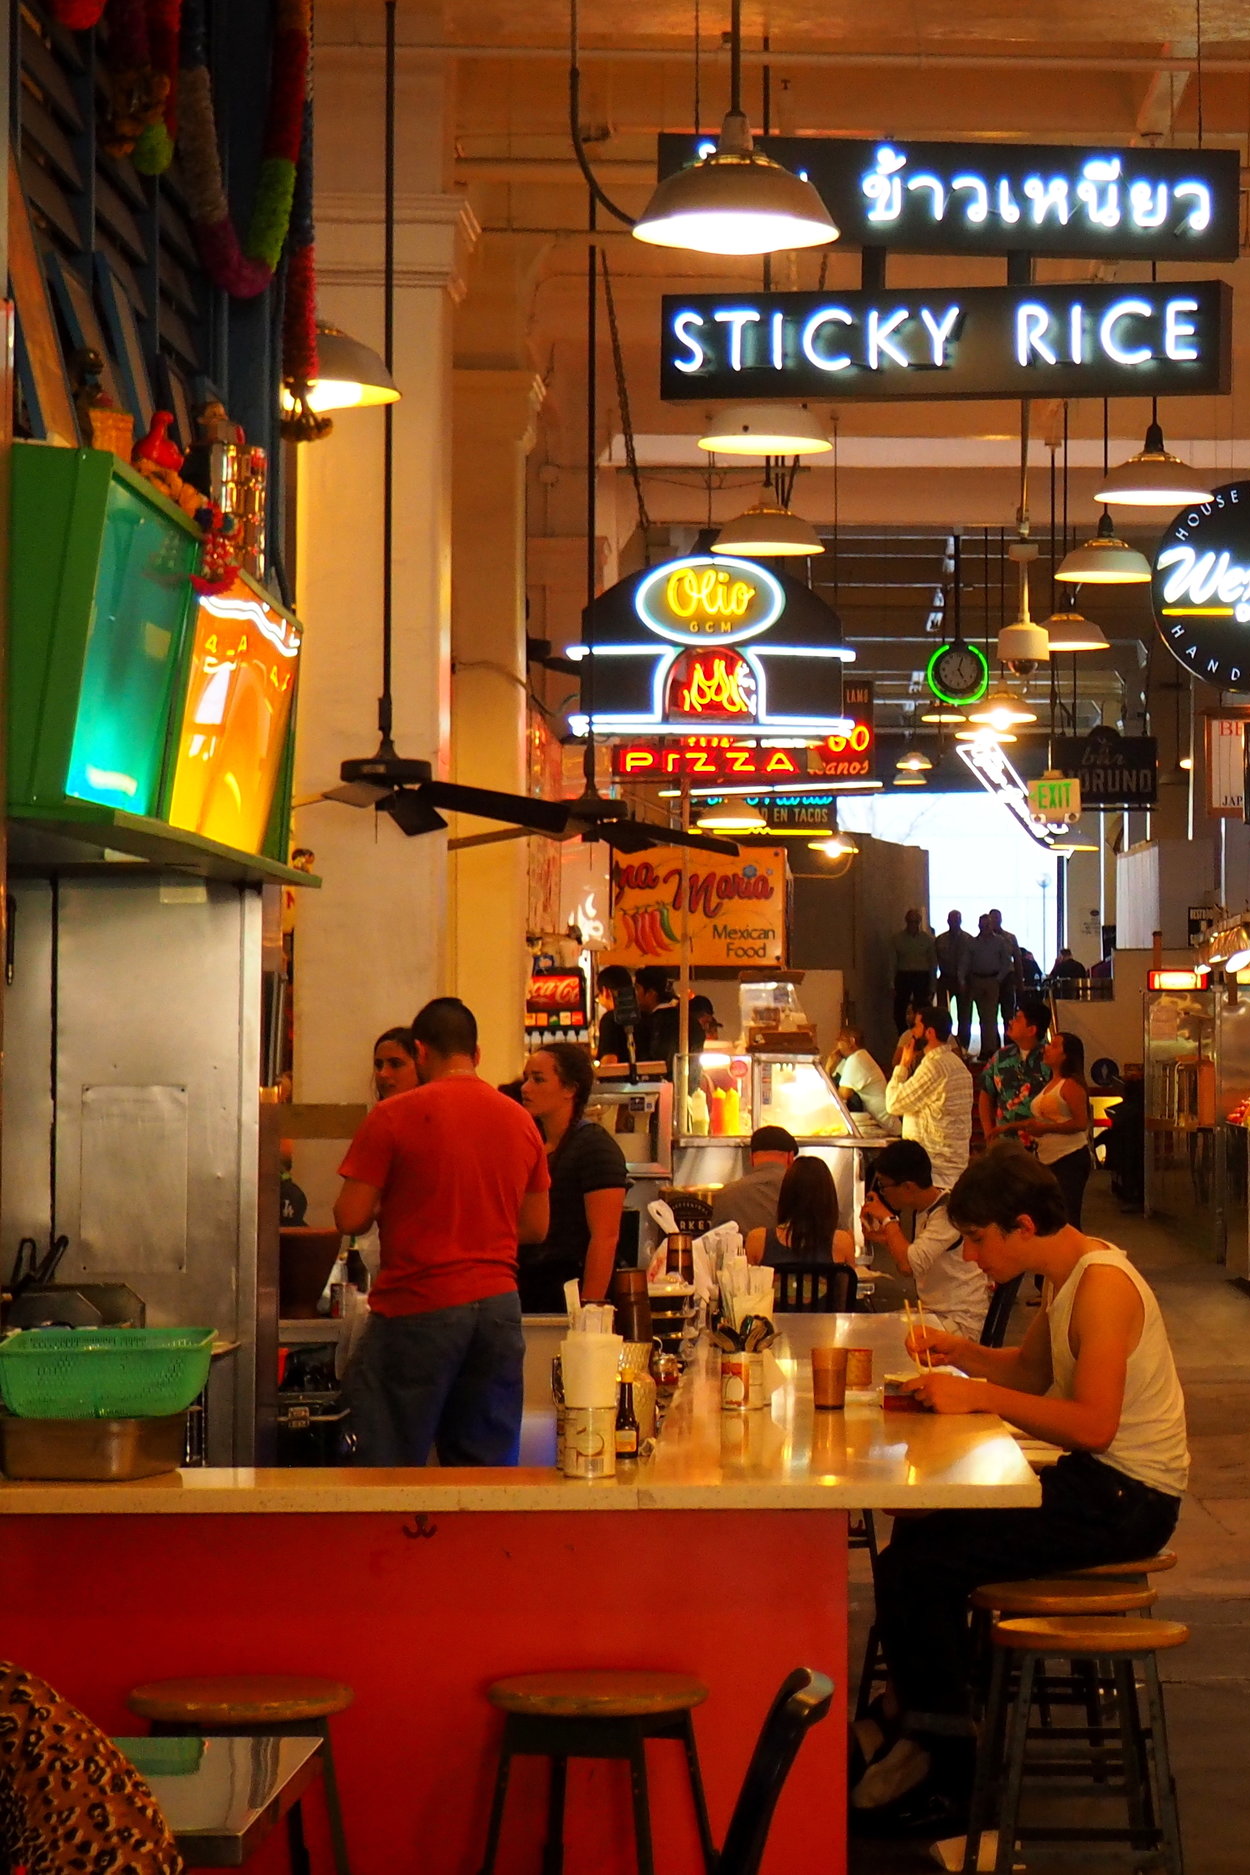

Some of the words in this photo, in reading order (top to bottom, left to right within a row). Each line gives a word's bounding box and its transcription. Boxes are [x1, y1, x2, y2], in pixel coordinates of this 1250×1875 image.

[861, 145, 1212, 233] ข้าวเหนียว
[672, 306, 960, 373] STICKY
[1016, 299, 1200, 368] RICE
[1175, 489, 1240, 542] HOUSE
[667, 567, 756, 617] Olio
[1171, 623, 1241, 682] HAND
[625, 751, 795, 773] PIZZA
[1037, 782, 1072, 809] EXIT
[712, 924, 776, 940] Mexican
[726, 943, 766, 958] Food
